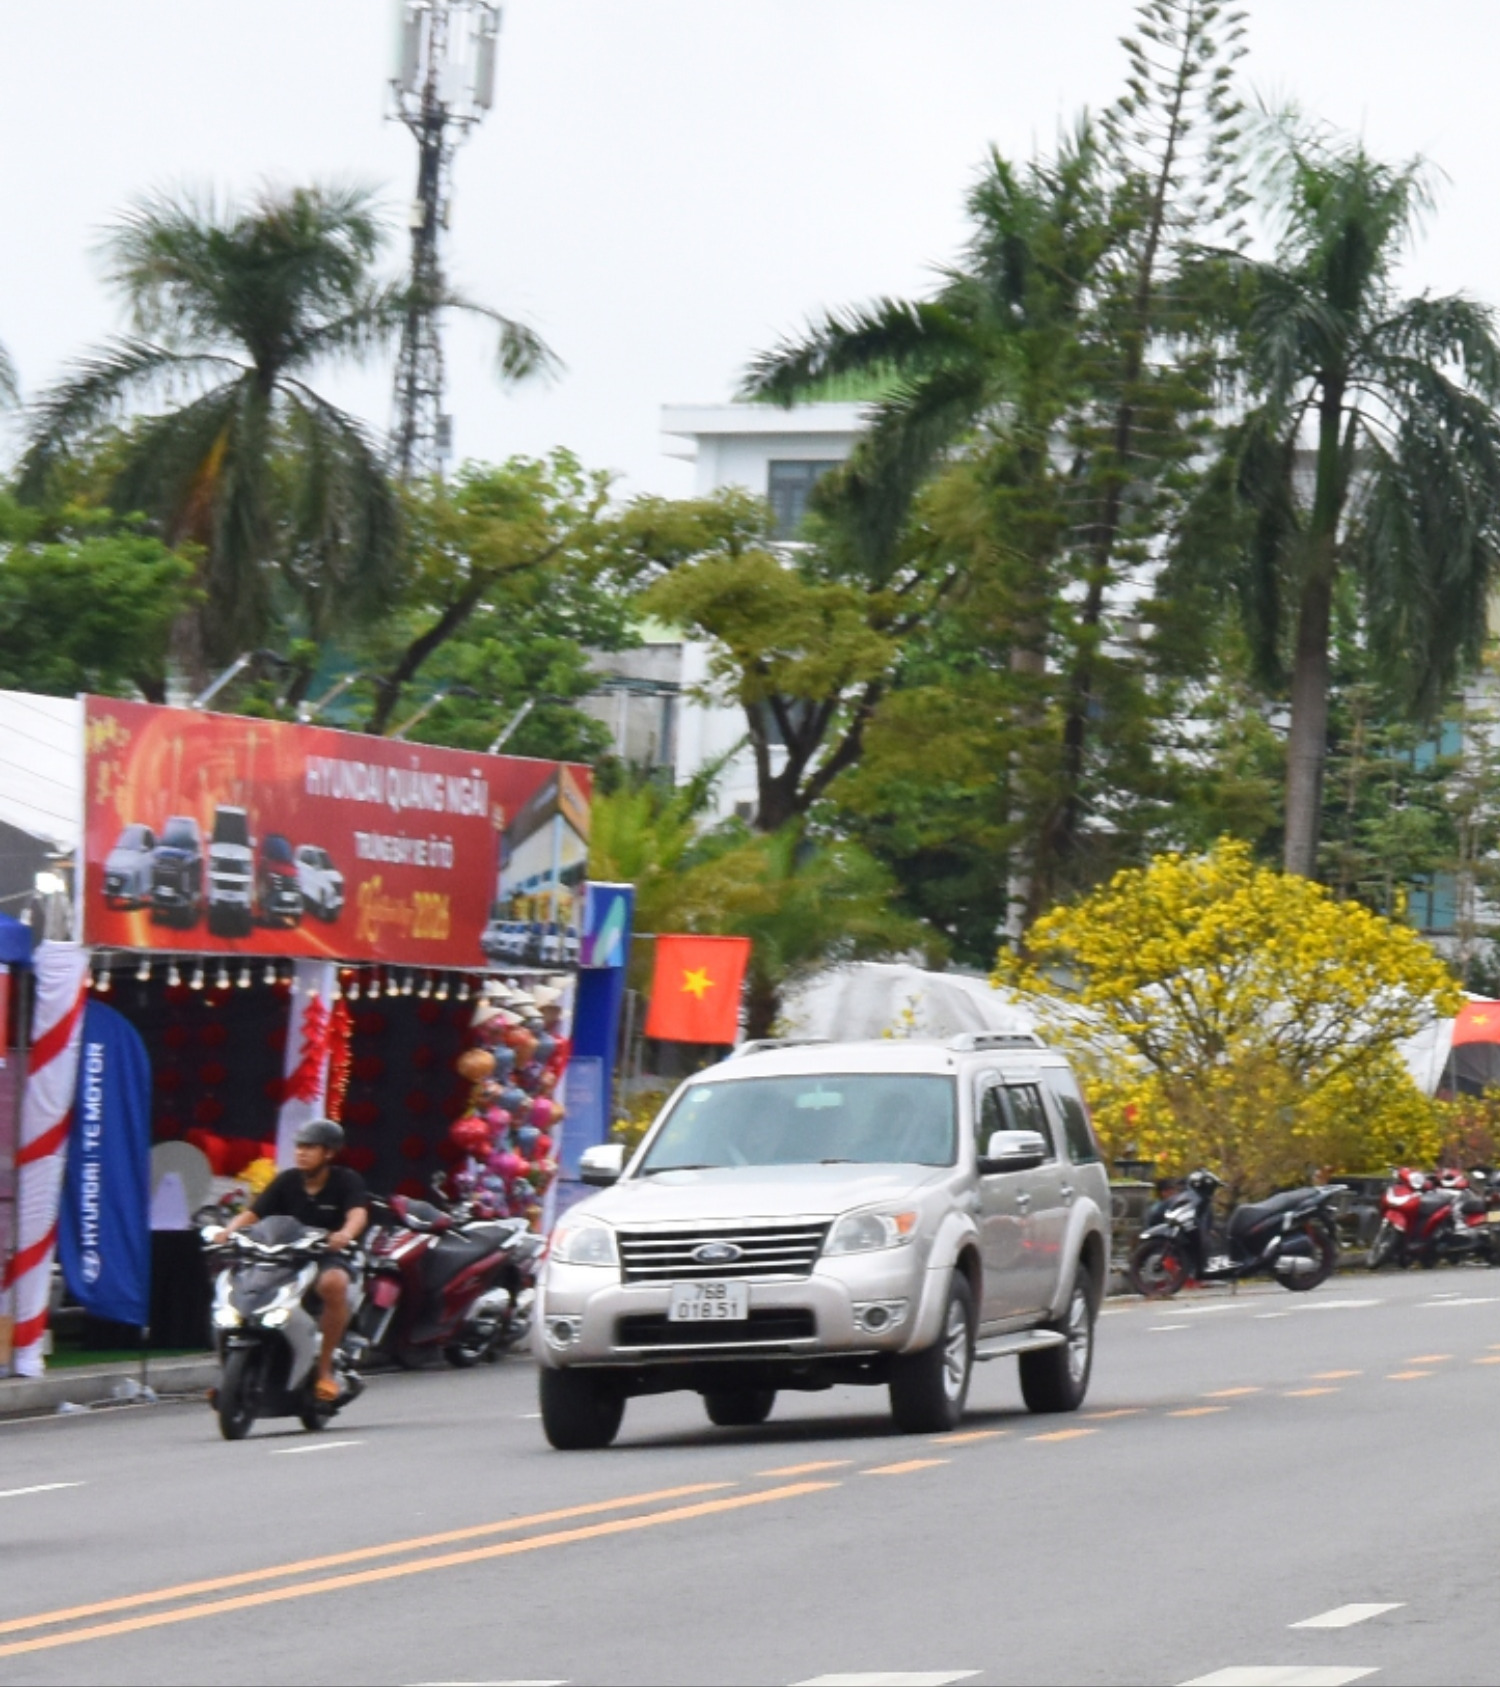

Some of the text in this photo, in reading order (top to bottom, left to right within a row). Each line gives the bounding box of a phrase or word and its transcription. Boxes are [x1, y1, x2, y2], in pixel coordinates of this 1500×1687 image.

[305, 755, 489, 817] HYUNDAI QUẢNG NGÃI
[84, 1042, 105, 1121] MOTOR
[81, 1163, 100, 1246] HYUNDAI
